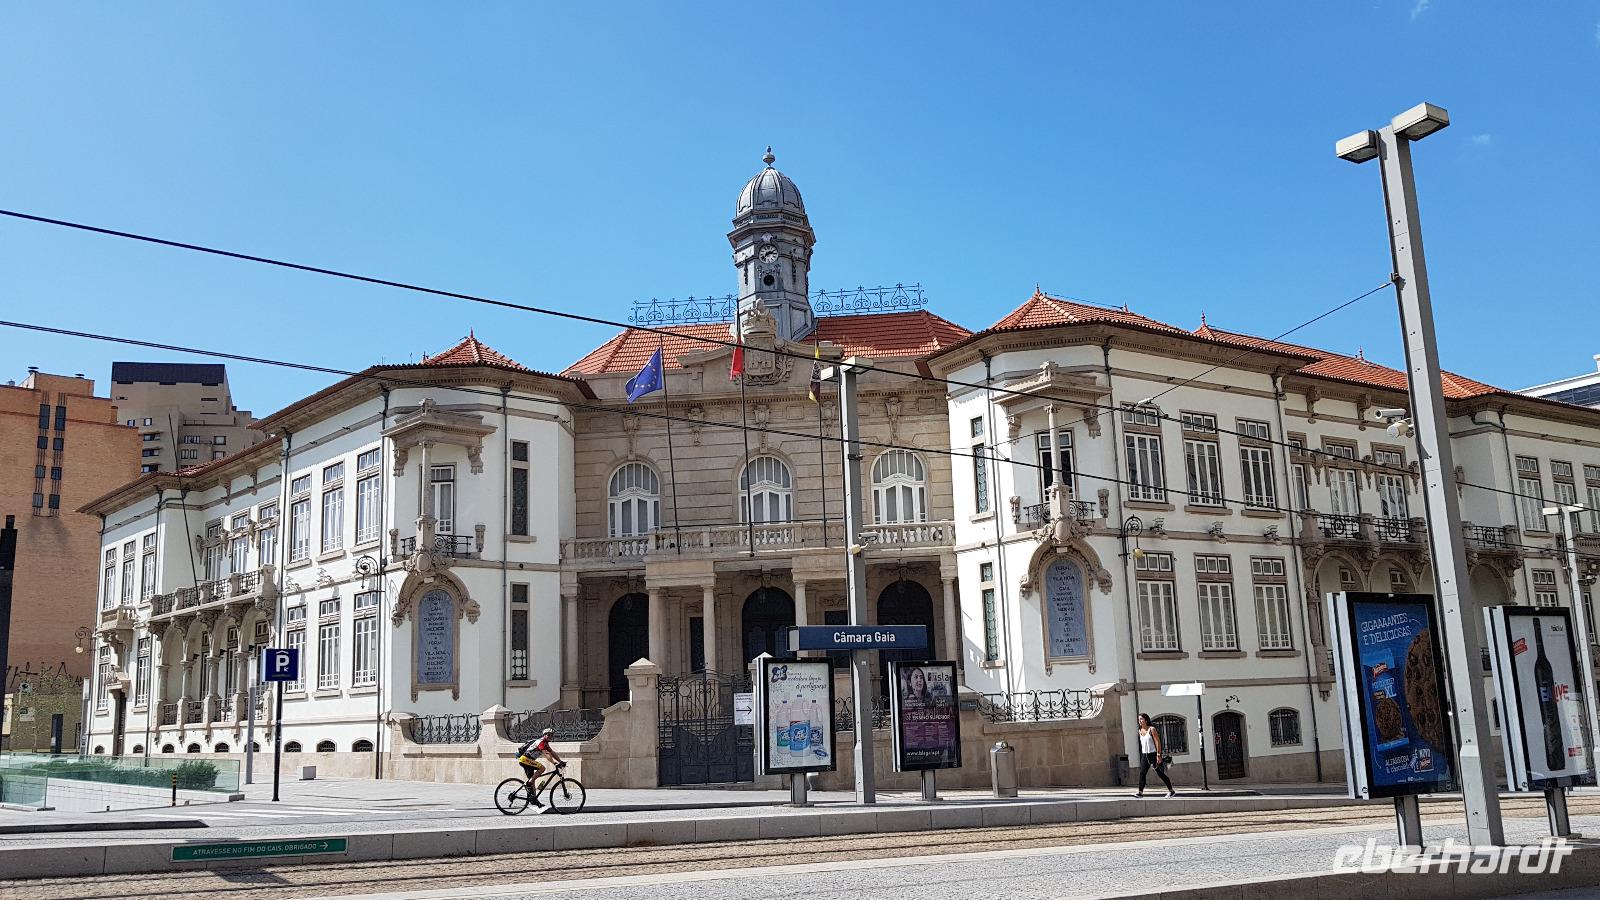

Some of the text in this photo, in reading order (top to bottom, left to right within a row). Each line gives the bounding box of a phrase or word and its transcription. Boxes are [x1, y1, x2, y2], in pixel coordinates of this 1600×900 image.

[833, 631, 896, 643] Câmara Gaia
[1363, 626, 1412, 645] E DELICIOSAS
[275, 654, 290, 672] P
[1384, 684, 1397, 699] XL
[192, 847, 231, 856] ATRAVESSE
[284, 843, 317, 851] OBRIGADO
